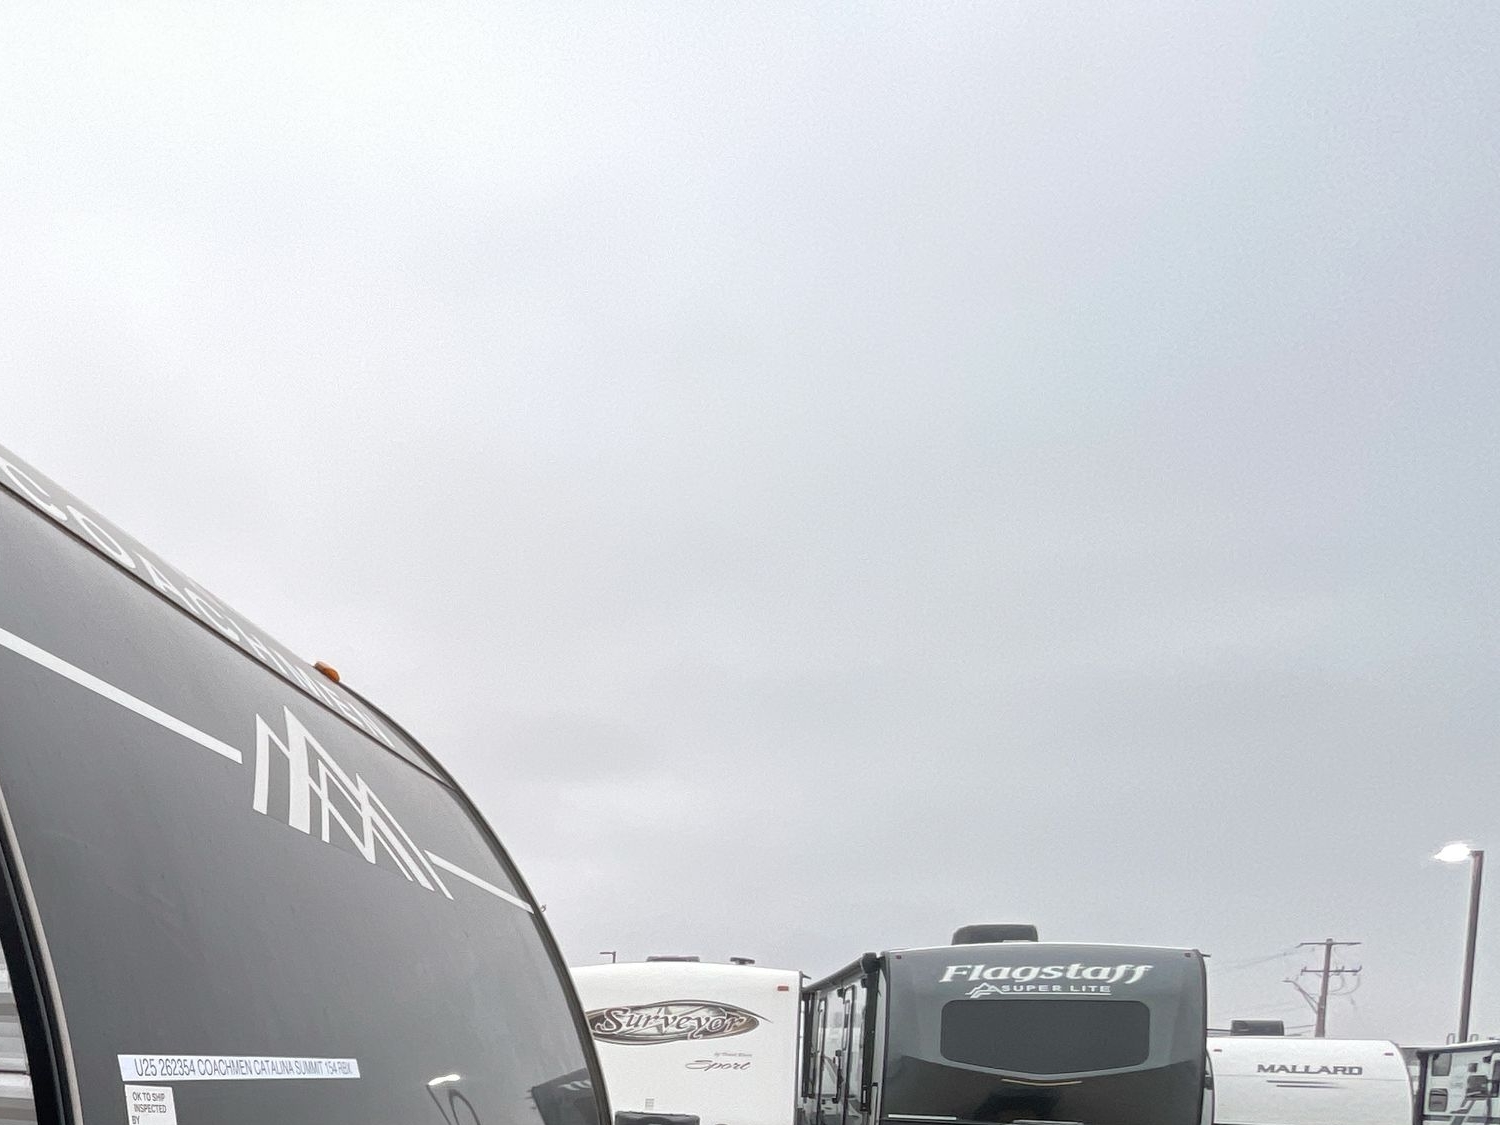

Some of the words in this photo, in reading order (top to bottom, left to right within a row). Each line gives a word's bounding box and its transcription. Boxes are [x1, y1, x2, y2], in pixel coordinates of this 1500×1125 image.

[939, 963, 1154, 984] Flagstaff
[1001, 984, 1062, 992] SUPER
[1070, 985, 1112, 993] LITE
[594, 1006, 746, 1040] Surveyor
[134, 1058, 157, 1076] U25
[158, 1058, 195, 1077] 262354
[197, 1058, 252, 1076] COACHMEN
[253, 1059, 293, 1075] CATALINA
[685, 1059, 751, 1071] Sport
[1257, 1064, 1363, 1075] MALLARD
[132, 1091, 141, 1101] OK
[142, 1092, 151, 1101] TO
[151, 1093, 165, 1102] SHIP
[133, 1104, 167, 1113] INSPECTED
[132, 1115, 140, 1125] BY
